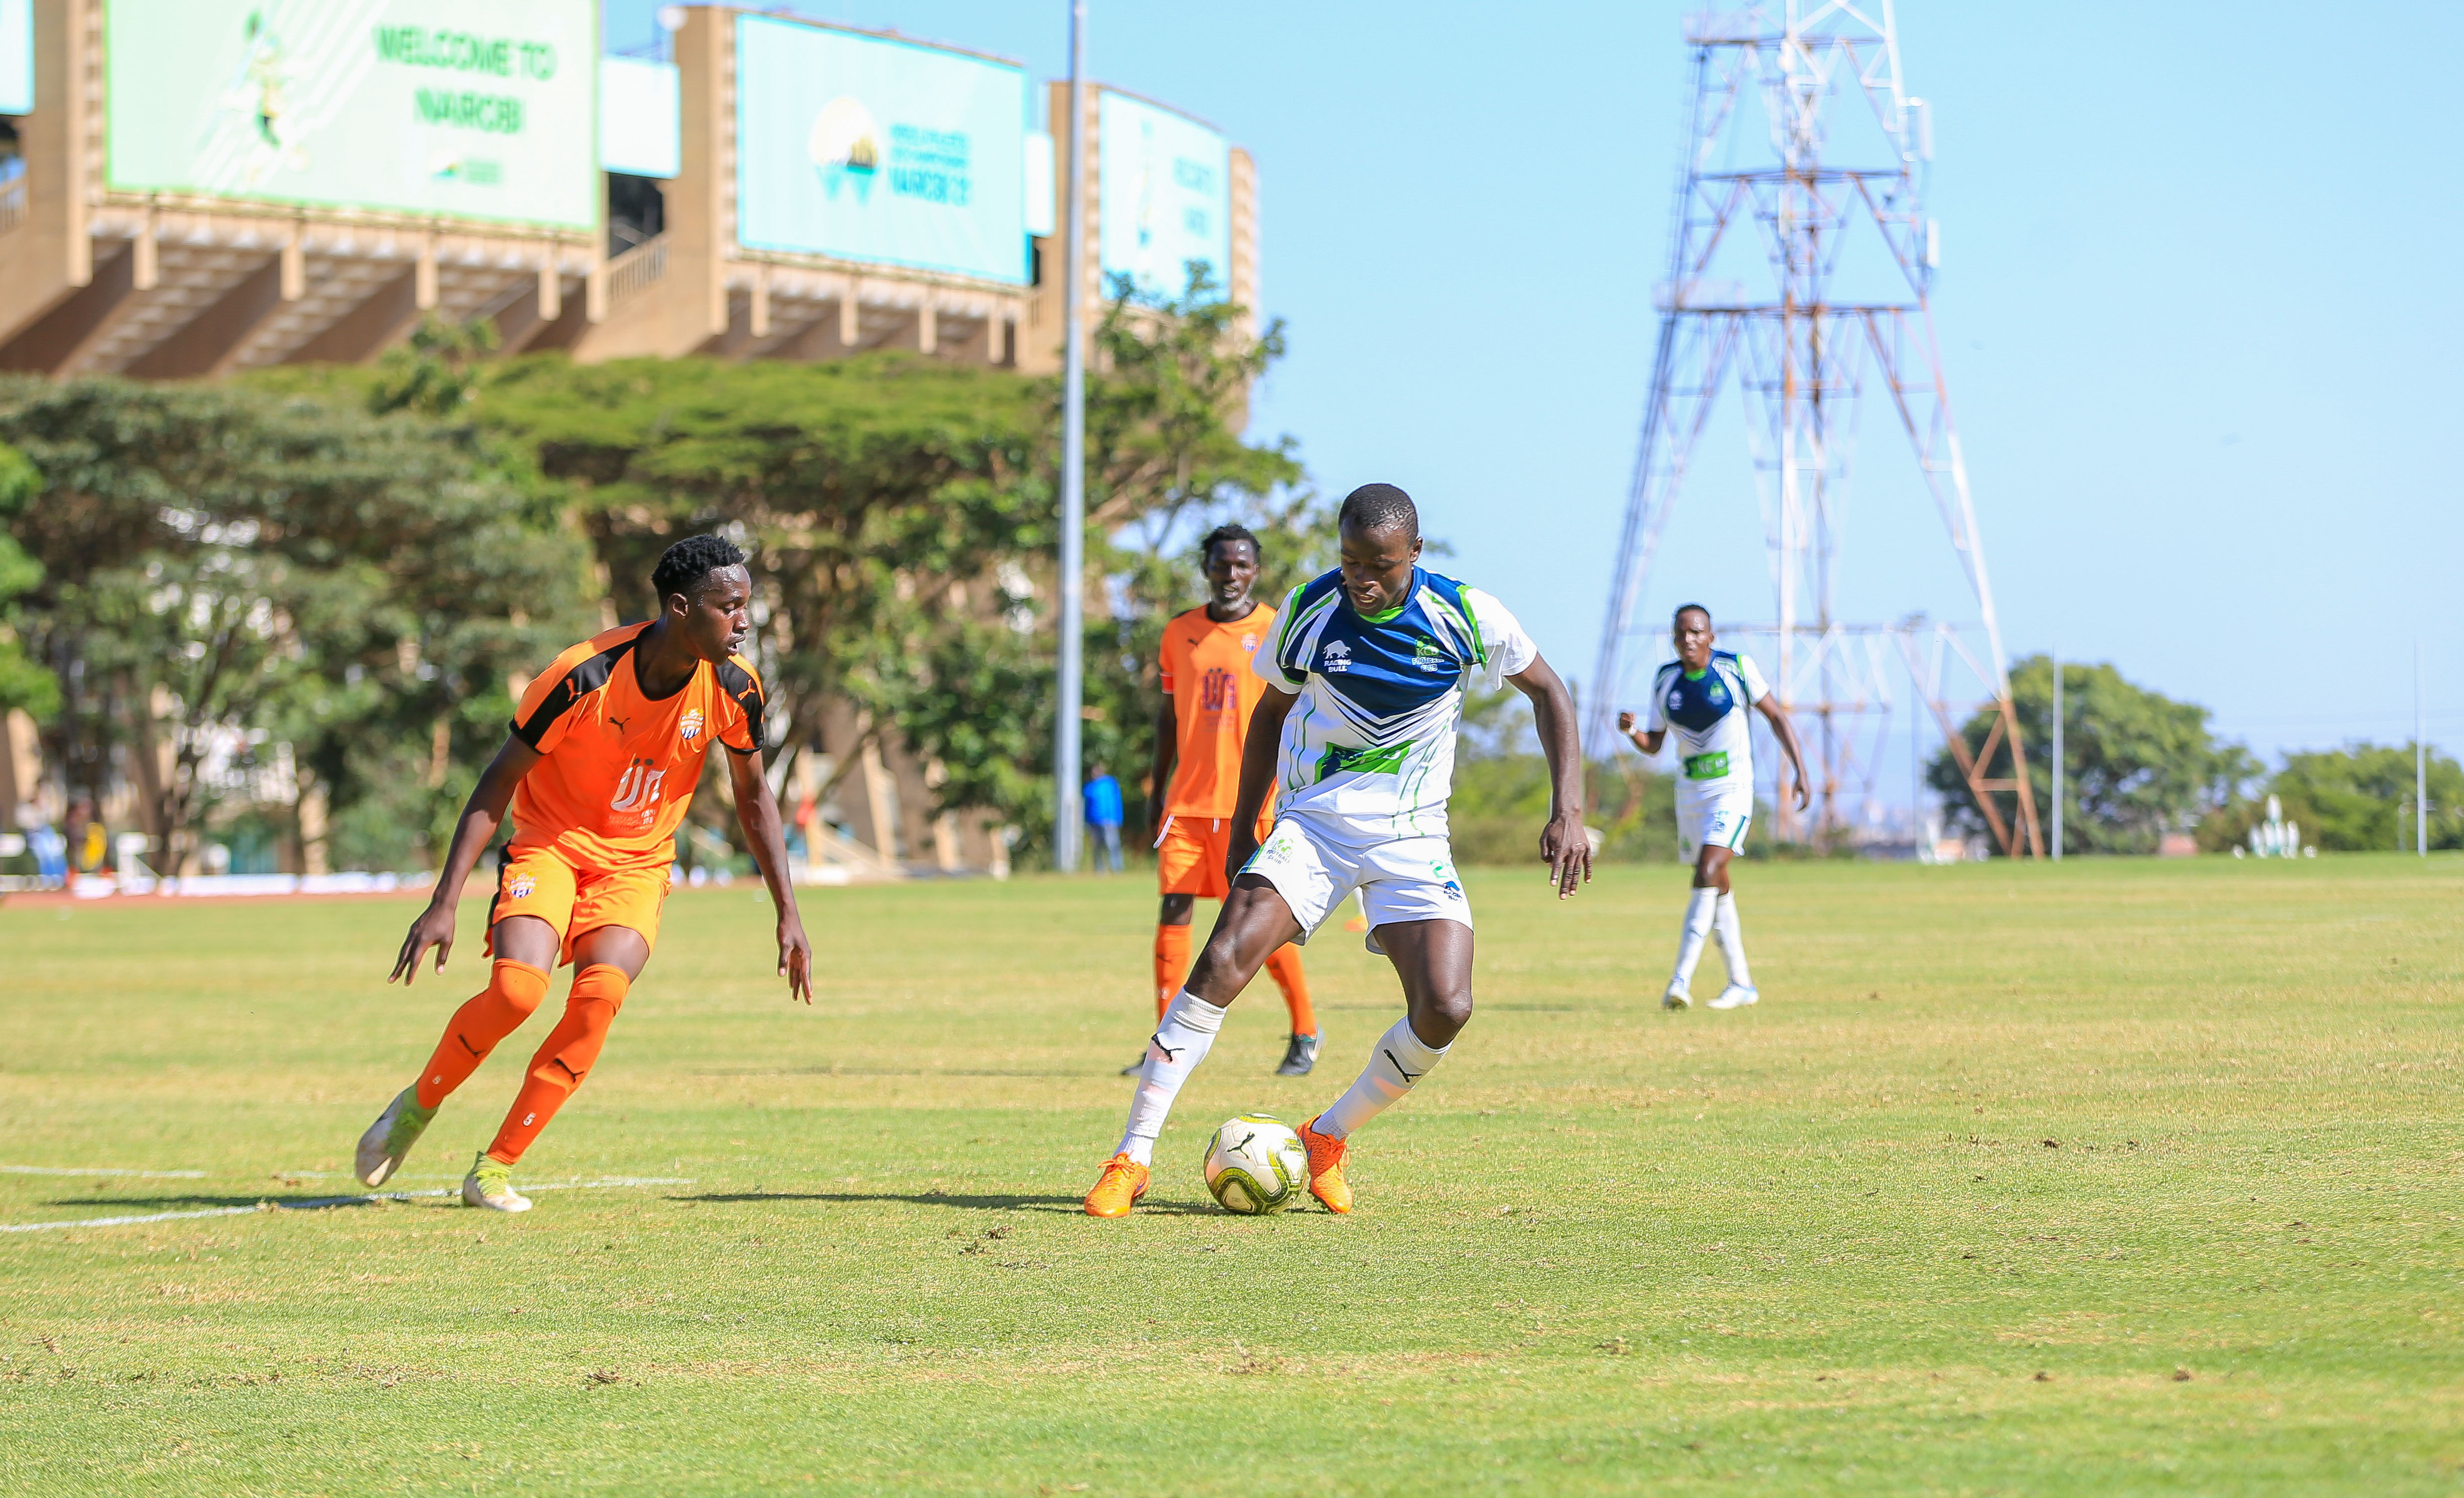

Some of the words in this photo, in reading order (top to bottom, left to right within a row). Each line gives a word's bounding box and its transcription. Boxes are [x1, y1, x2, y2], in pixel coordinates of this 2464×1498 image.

[373, 26, 513, 77] WELCOME
[520, 40, 557, 81] TO
[523, 1111, 537, 1126] 5
